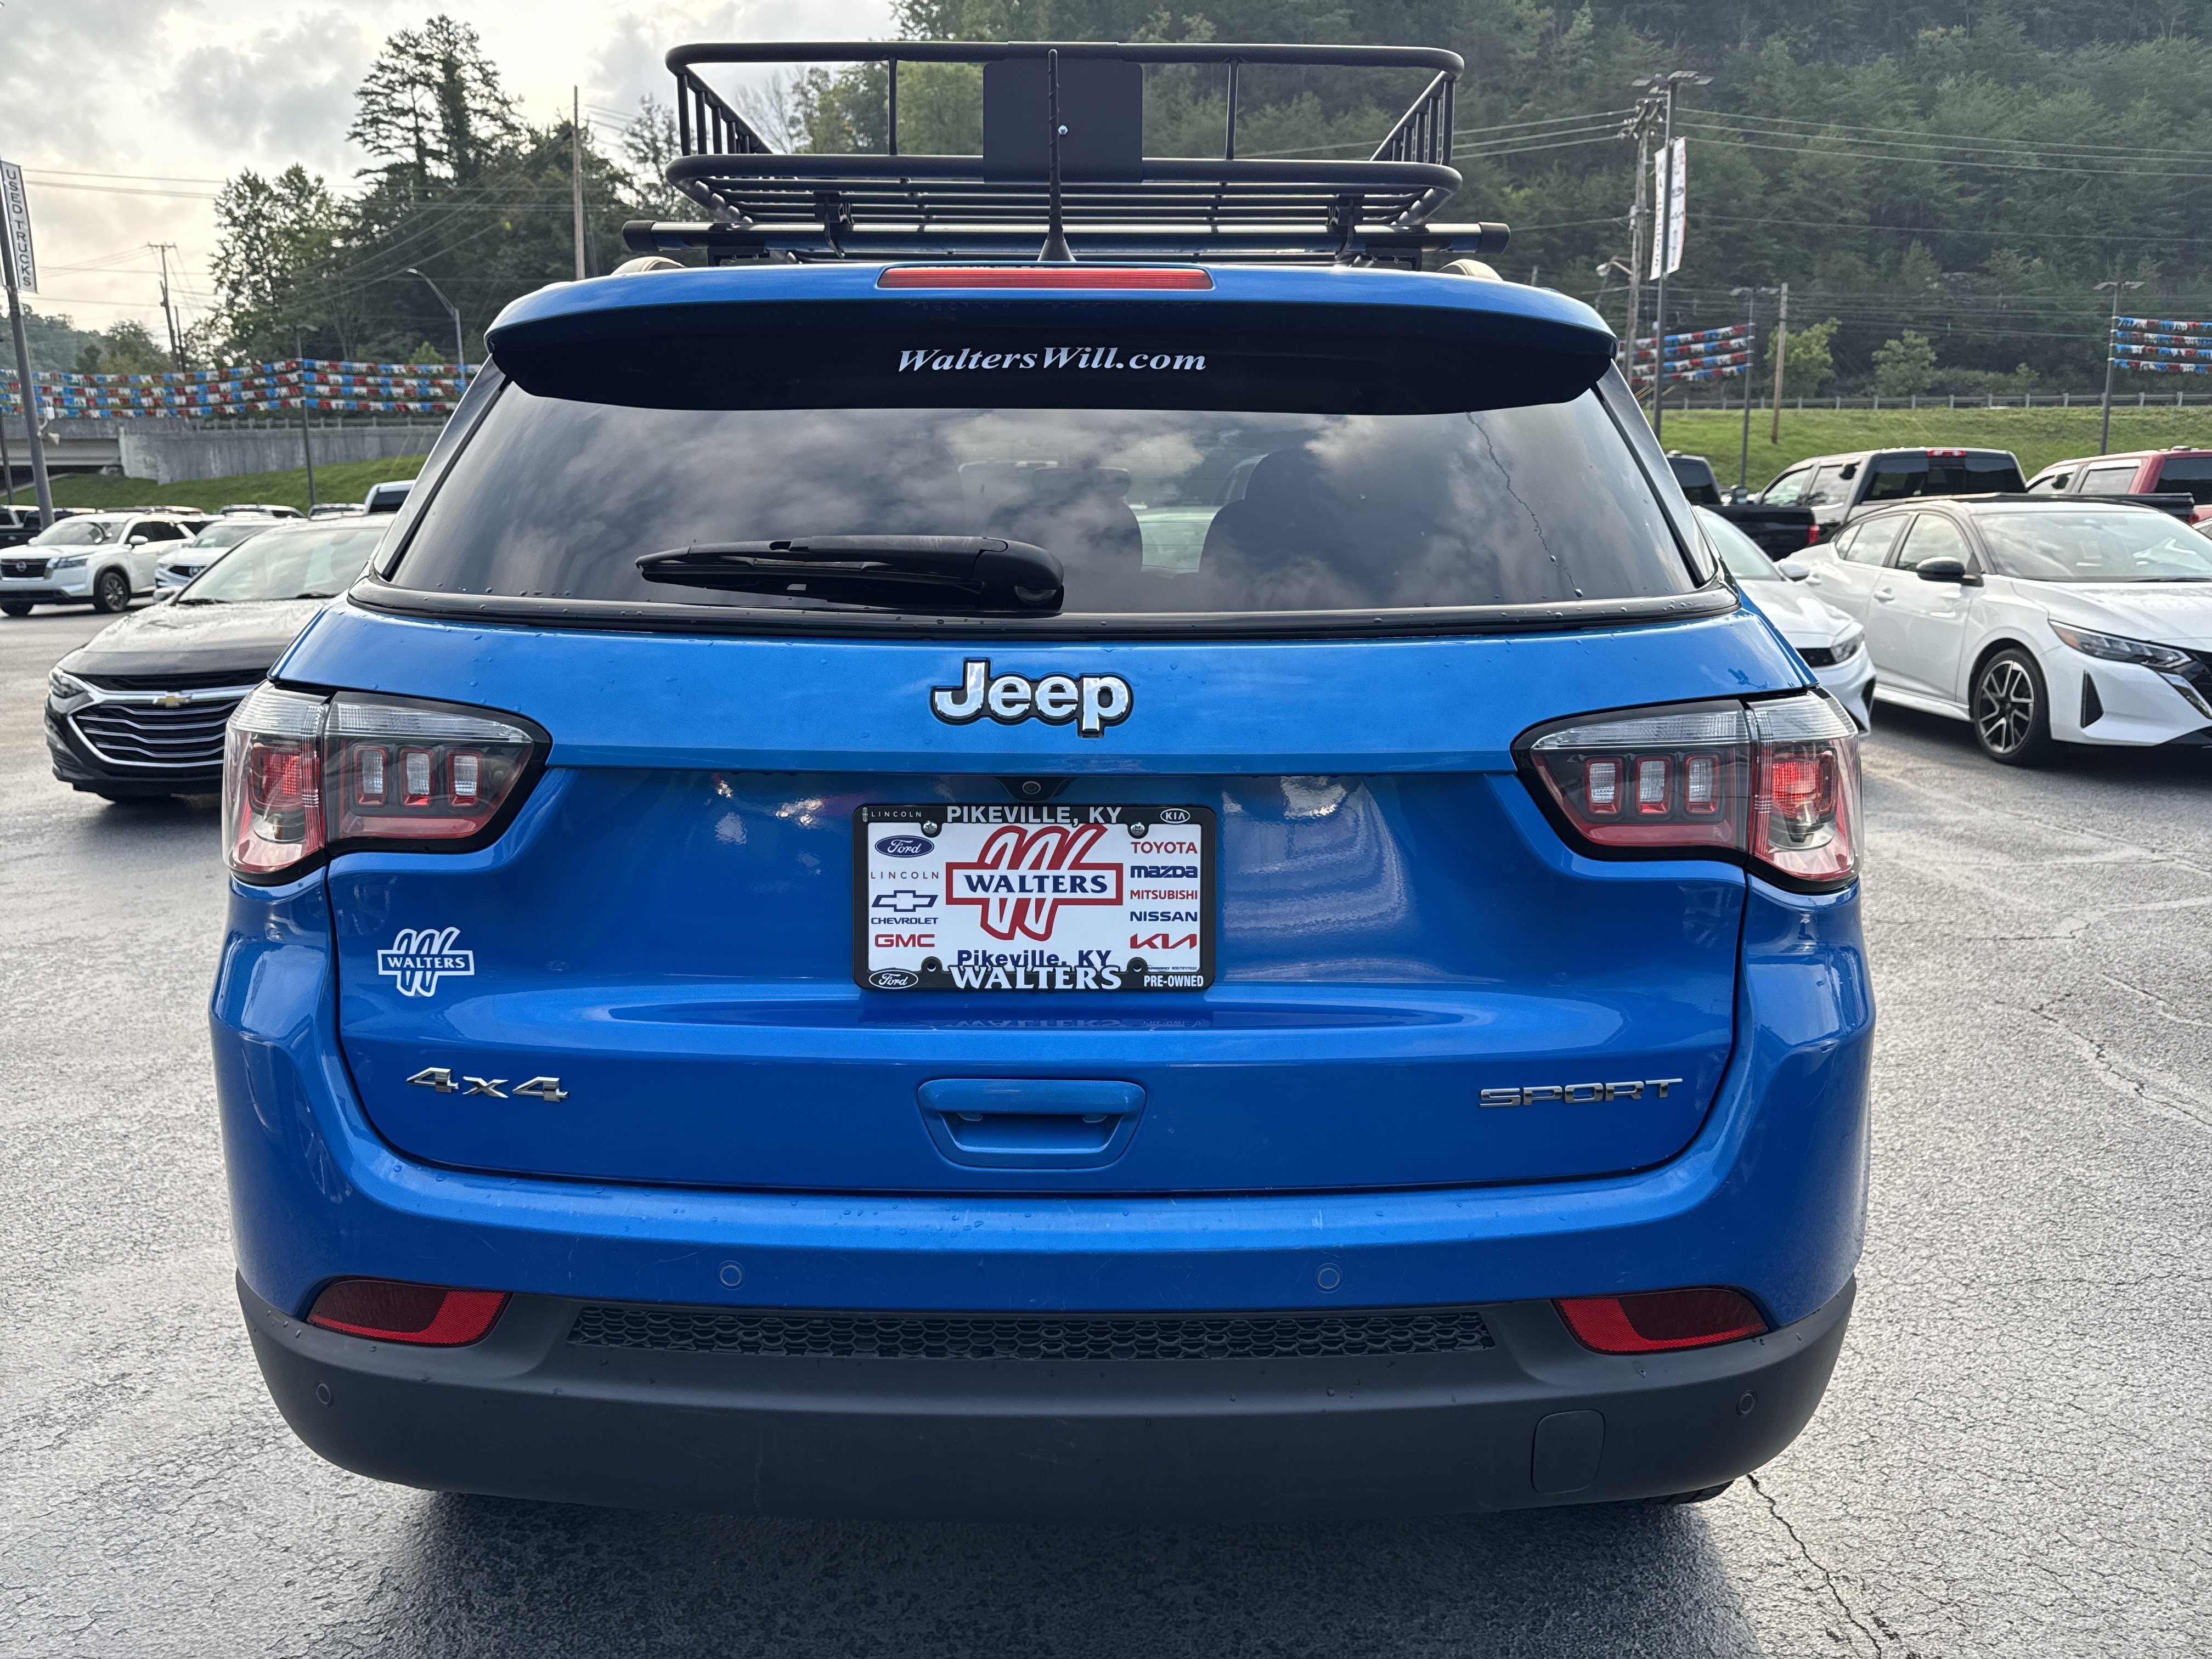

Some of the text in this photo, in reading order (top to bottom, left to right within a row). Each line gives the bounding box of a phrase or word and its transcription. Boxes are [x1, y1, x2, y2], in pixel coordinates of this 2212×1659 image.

[6, 169, 31, 286] USED TRUCKS
[899, 347, 1206, 371] WaltersWill.com
[933, 661, 1130, 734] Jeep
[946, 805, 1122, 827] PIKEVILLE, KY
[1165, 811, 1186, 820] KIA
[887, 839, 922, 854] Ford
[1131, 842, 1198, 854] TOYOTA
[871, 871, 939, 879] LINCOLN
[963, 874, 1108, 894] WALTERS
[1130, 890, 1198, 900] MITSUBISHI
[1130, 911, 1198, 922] NISSAN
[874, 934, 935, 947] GMC
[387, 956, 466, 969] WALTERS
[1078, 950, 1112, 967] KY
[878, 973, 909, 986] Ford
[948, 966, 1122, 989] WALTERS
[1144, 975, 1204, 987] PRE-OWNED
[406, 1067, 568, 1102] 4x4
[1479, 1078, 1683, 1108] SPORT
